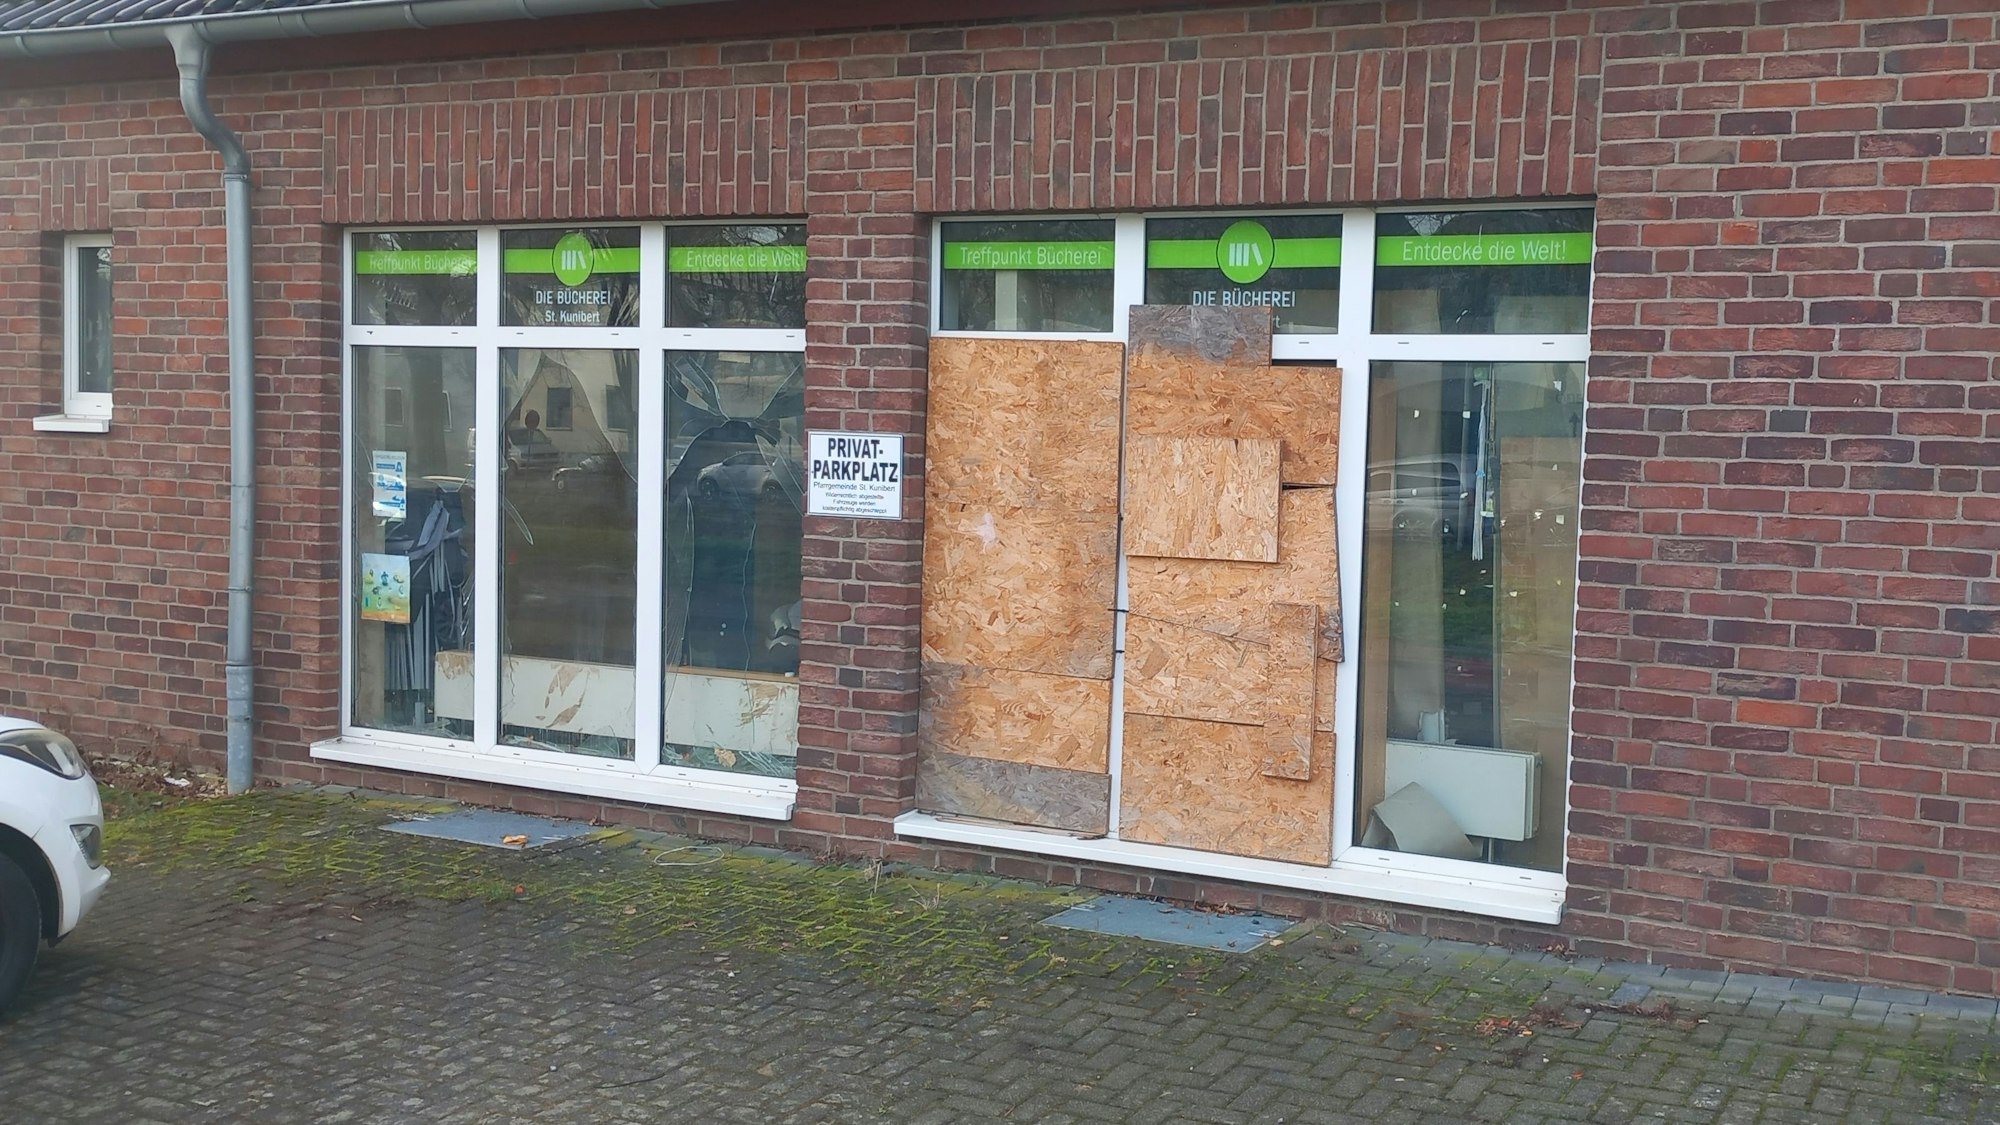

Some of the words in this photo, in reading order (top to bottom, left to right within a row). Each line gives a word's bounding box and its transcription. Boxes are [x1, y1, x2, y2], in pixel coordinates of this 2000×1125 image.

[686, 250, 744, 268] Entdecke
[748, 250, 768, 268] die
[960, 246, 1032, 268] Treffpunkt
[1036, 245, 1101, 265] Bücherei
[1402, 240, 1483, 262] Entdecke
[1488, 240, 1515, 261] die
[1521, 240, 1566, 261] Welt!
[368, 254, 420, 272] Treffpunkt
[535, 290, 554, 305] DIE
[557, 287, 611, 305] BÜCHEREI
[1192, 290, 1217, 306] DIE
[1222, 287, 1296, 307] BÜCHEREI
[545, 310, 558, 322] St.
[560, 310, 600, 323] Kunibert
[828, 437, 884, 459] PRIVAT-
[813, 459, 898, 483] PARKPLATZ
[813, 481, 858, 491] Pfarrgemeinde
[869, 484, 896, 492] Kunibert
